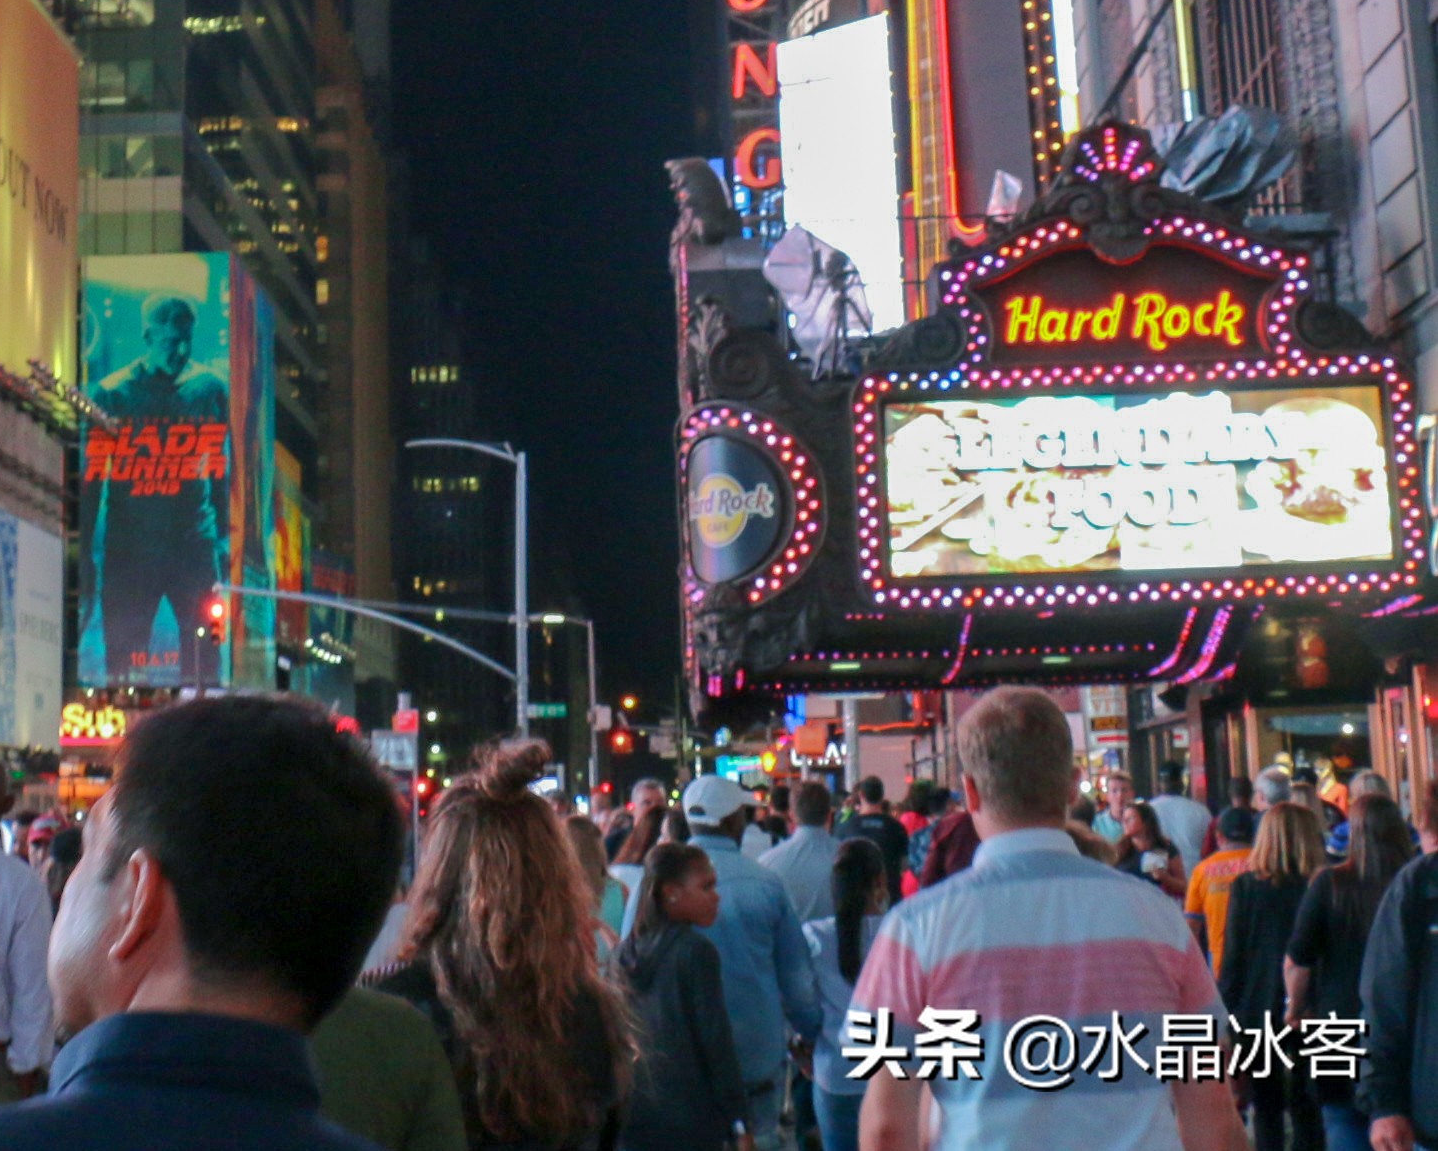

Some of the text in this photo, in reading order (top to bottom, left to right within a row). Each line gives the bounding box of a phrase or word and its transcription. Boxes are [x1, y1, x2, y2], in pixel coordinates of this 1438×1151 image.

[1004, 289, 1246, 351] Hard Rock
[85, 423, 228, 456] BLADE
[83, 454, 228, 482] RUNNER
[717, 483, 775, 518] Rock
